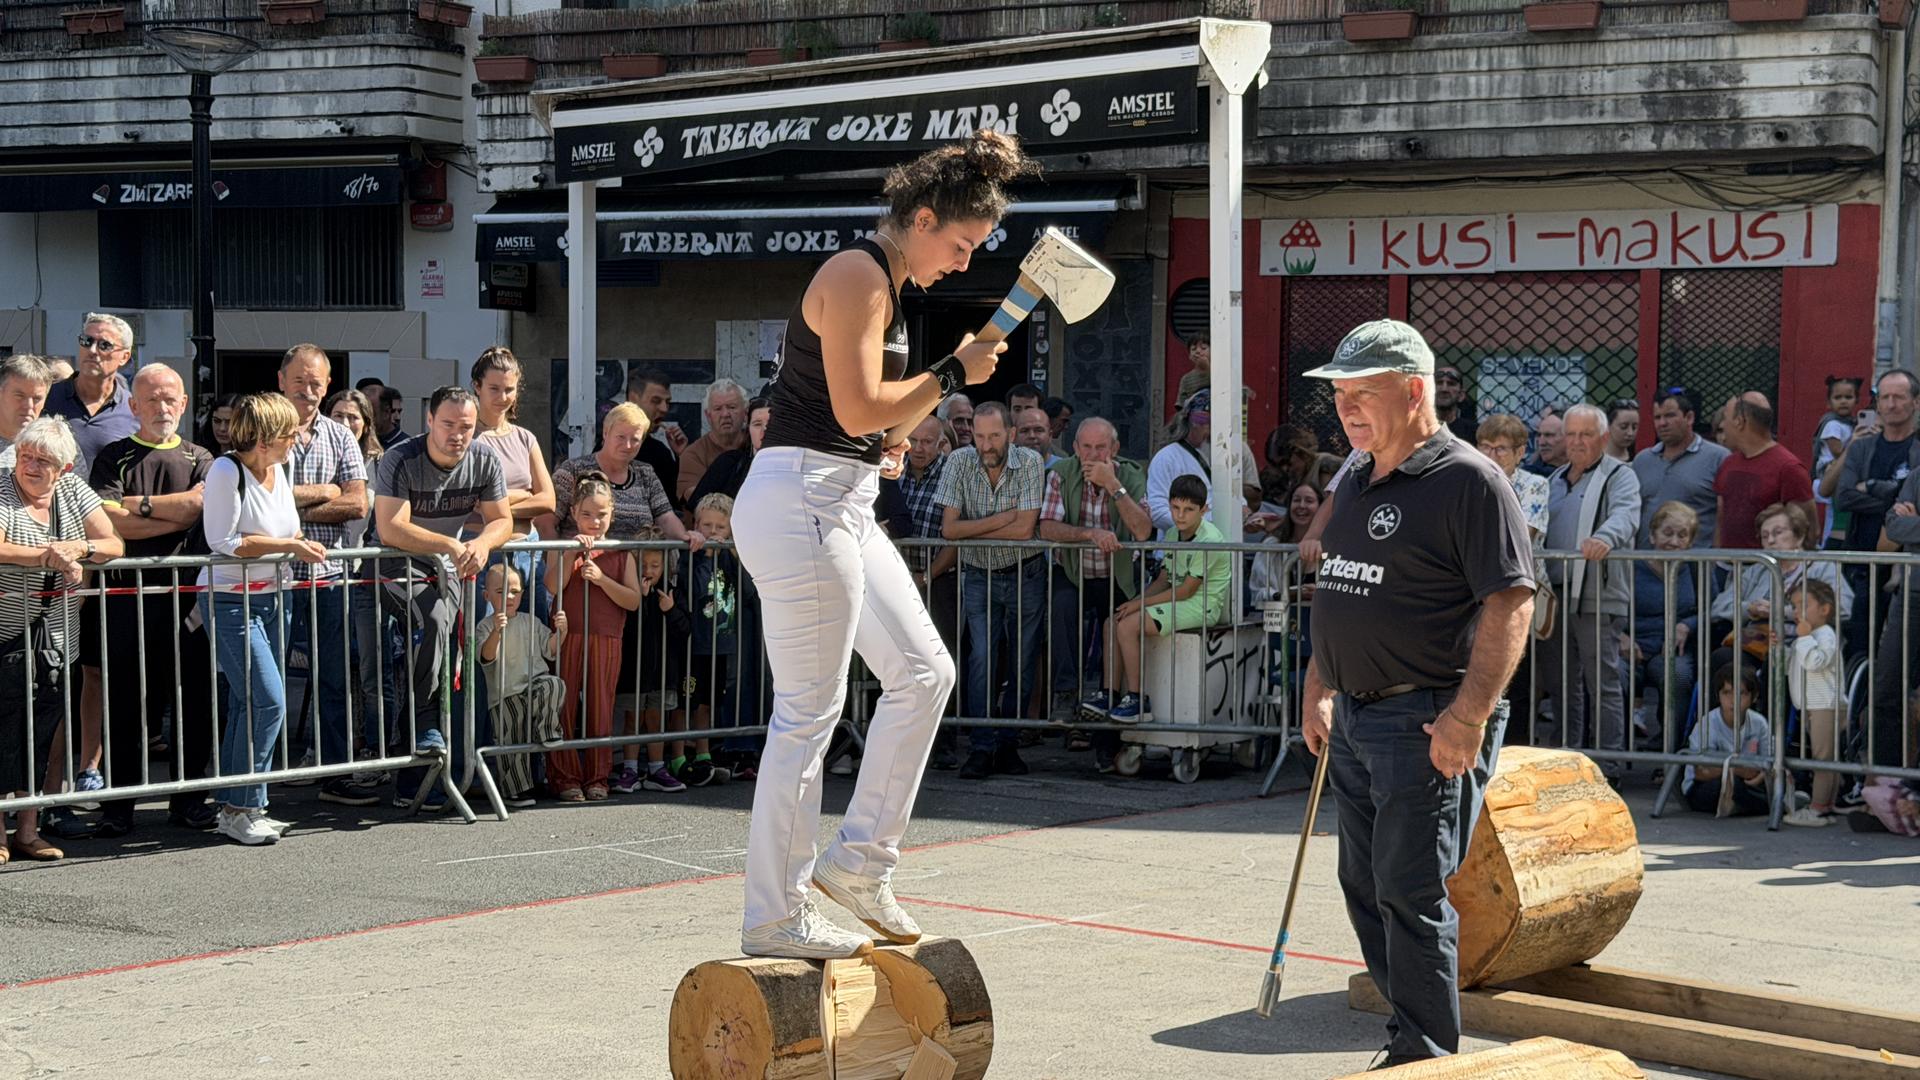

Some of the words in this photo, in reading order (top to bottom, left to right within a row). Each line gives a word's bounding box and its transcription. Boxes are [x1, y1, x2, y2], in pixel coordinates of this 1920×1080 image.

[1108, 92, 1175, 115] AMSTEL
[680, 116, 820, 159] TABERNA
[826, 111, 914, 142] JOXE
[571, 142, 616, 162] AMSTEL
[495, 236, 535, 248] AMSTEL
[619, 231, 754, 256] TABERNA
[766, 230, 840, 253] JOXE
[1032, 226, 1080, 239] ATEL
